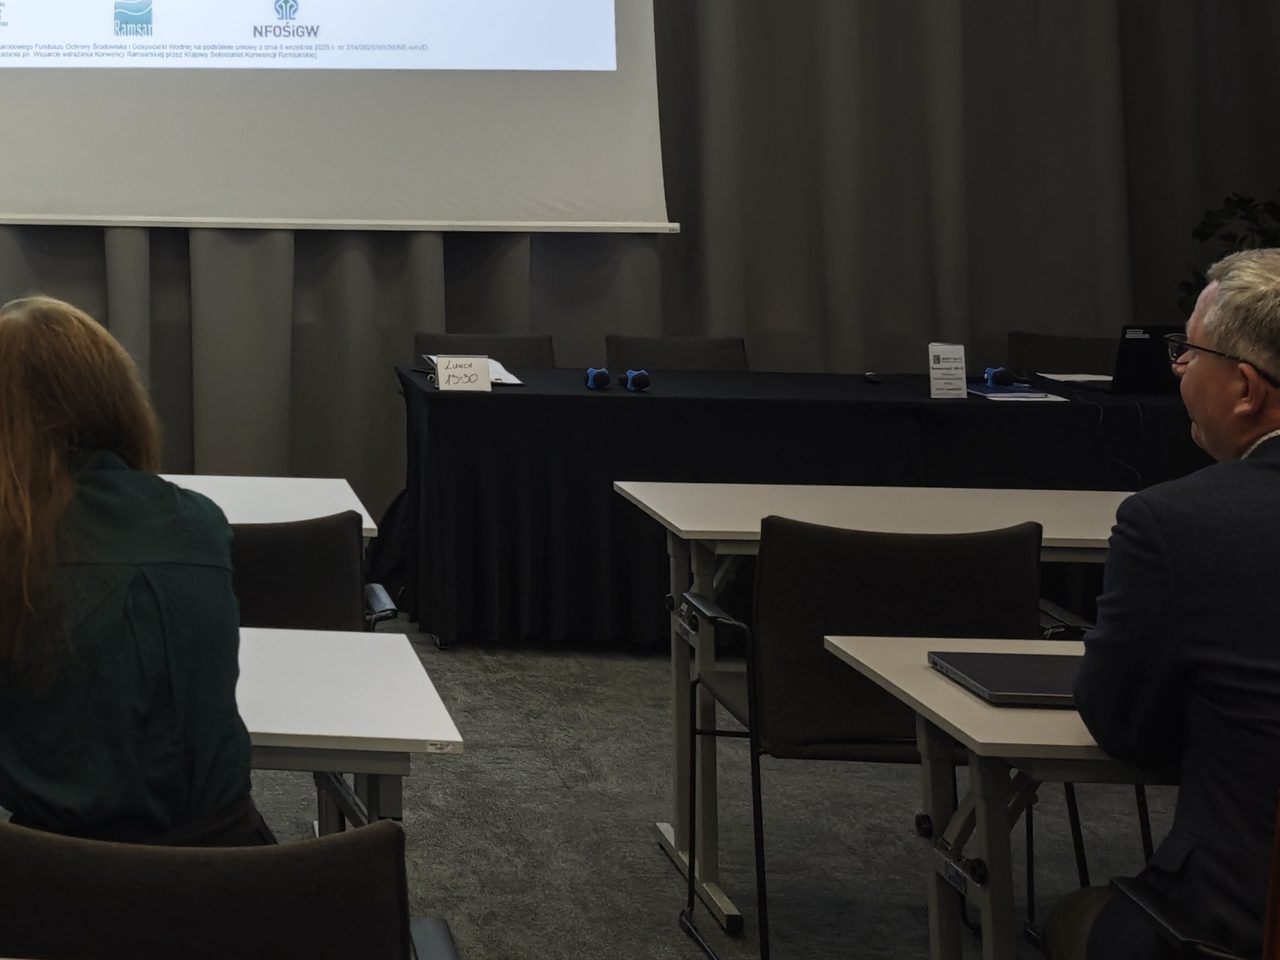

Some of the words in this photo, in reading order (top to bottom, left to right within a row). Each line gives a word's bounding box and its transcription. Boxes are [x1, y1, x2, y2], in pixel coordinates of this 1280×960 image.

[114, 20, 152, 36] Ramsar
[253, 21, 320, 38] NFOŚiGW
[65, 43, 91, 52] Ochrony
